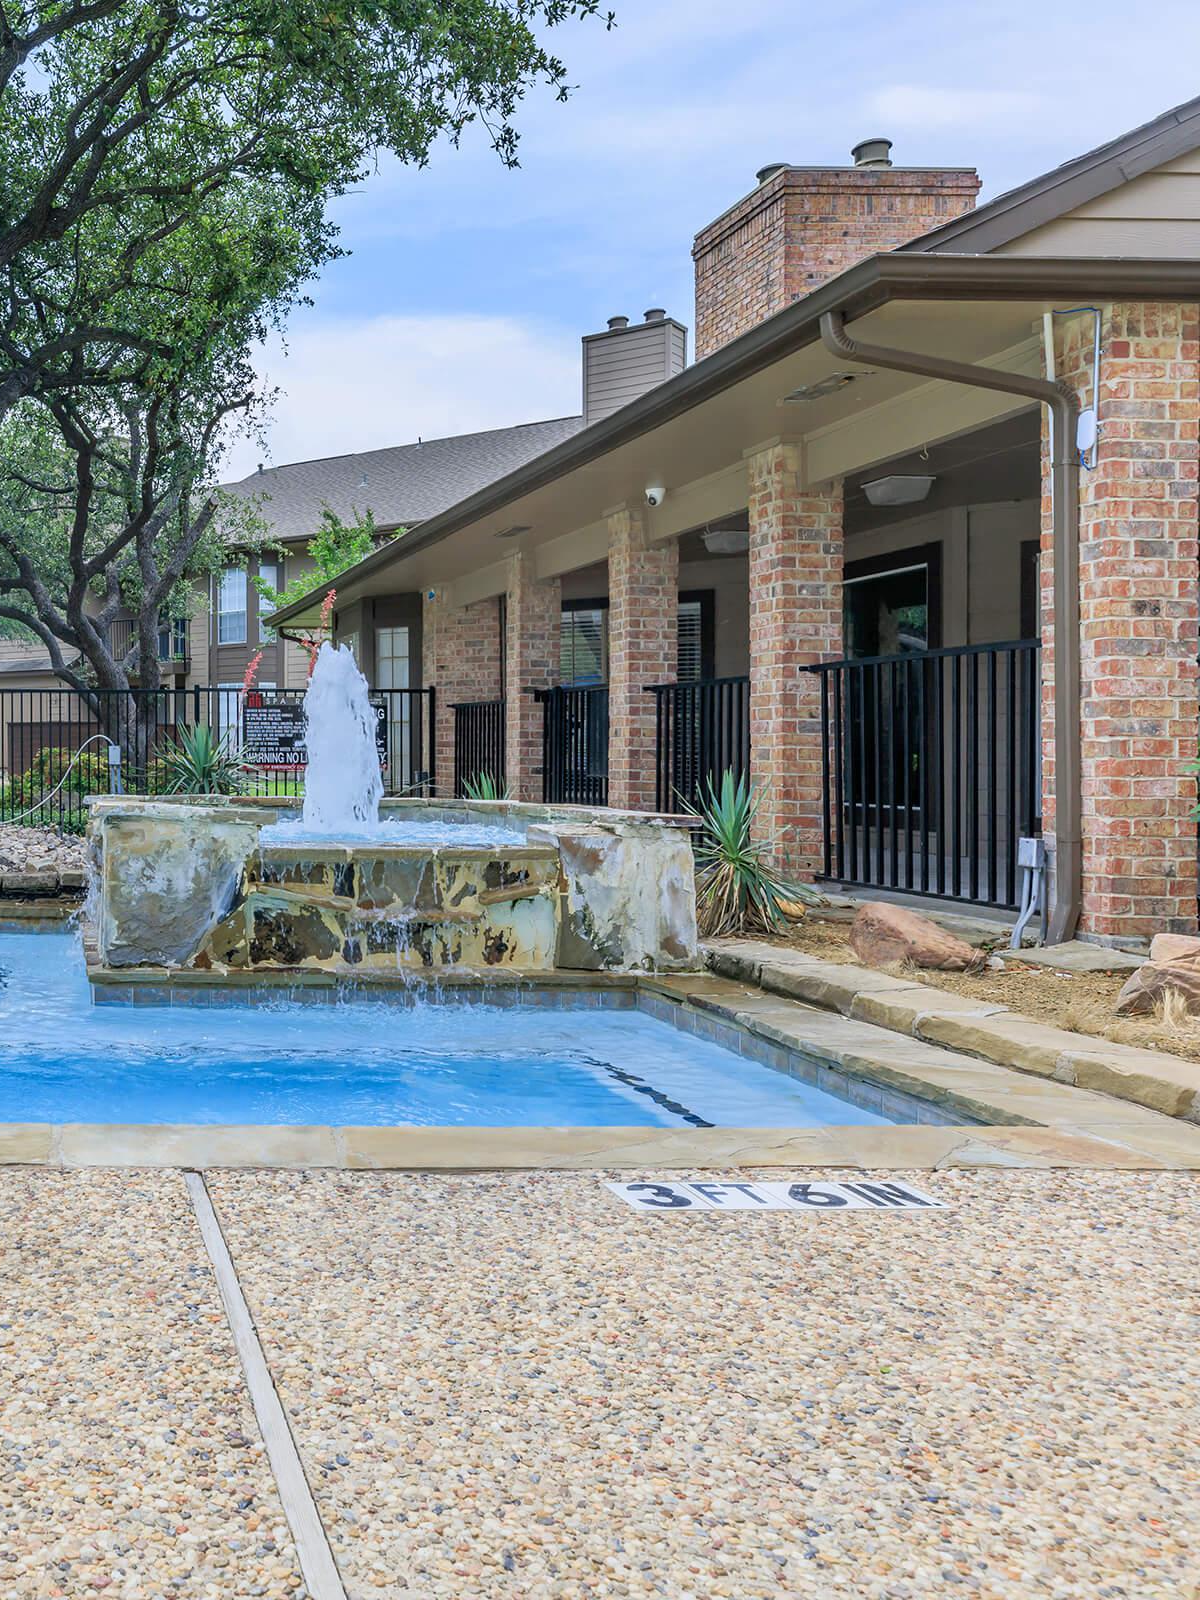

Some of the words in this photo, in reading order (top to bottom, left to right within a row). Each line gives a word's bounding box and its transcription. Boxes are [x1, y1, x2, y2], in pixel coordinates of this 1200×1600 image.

[265, 697, 287, 705] SPA
[246, 752, 285, 763] WARNING
[286, 752, 300, 763] NO
[626, 1183, 692, 1208] 3
[688, 1183, 769, 1205] FT
[787, 1183, 849, 1208] 6
